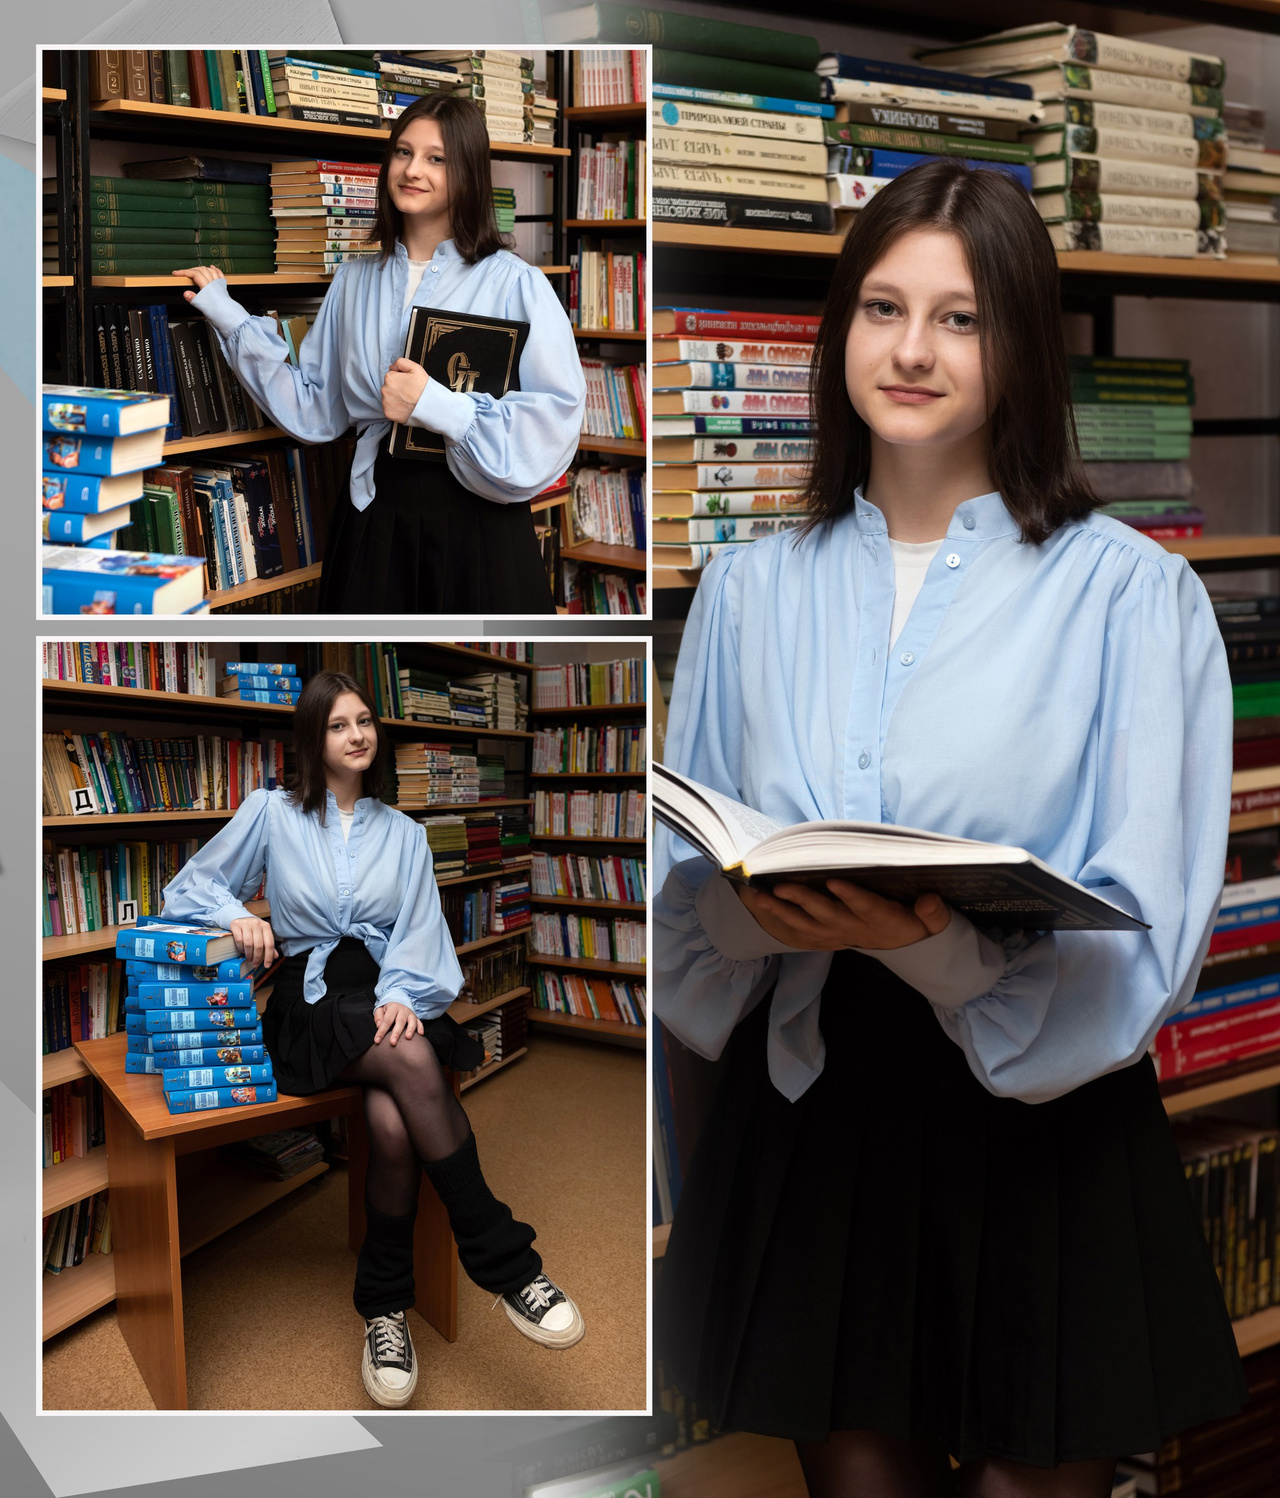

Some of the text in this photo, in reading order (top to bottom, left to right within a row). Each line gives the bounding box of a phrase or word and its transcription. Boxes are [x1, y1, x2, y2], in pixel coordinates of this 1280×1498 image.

[110, 78, 118, 88] 2
[264, 73, 274, 104] САДОВЫЕ
[680, 110, 787, 132] ПРИРОДА МОЕЙ СТРАНЫ
[872, 108, 940, 130] БОТАНИКА
[684, 140, 722, 156] ЧАРЛЗ
[684, 166, 722, 184] ЧАРЛЗ
[704, 206, 728, 221] МИР
[698, 318, 804, 334] географических названий
[134, 338, 144, 380] САМАРОВО
[144, 338, 154, 380] САМАРОВО
[740, 344, 764, 362] МИР
[181, 358, 192, 389] СИБИРСКАЯ
[746, 368, 769, 386] МИР
[742, 394, 767, 411] МИР
[752, 442, 778, 460] МИР
[754, 467, 780, 486] МИР
[750, 494, 776, 512] МИР
[228, 497, 240, 548] ТЮМЕНСКАЯ
[750, 520, 774, 538] МИР
[74, 789, 94, 812] Д
[122, 902, 134, 921] Л
